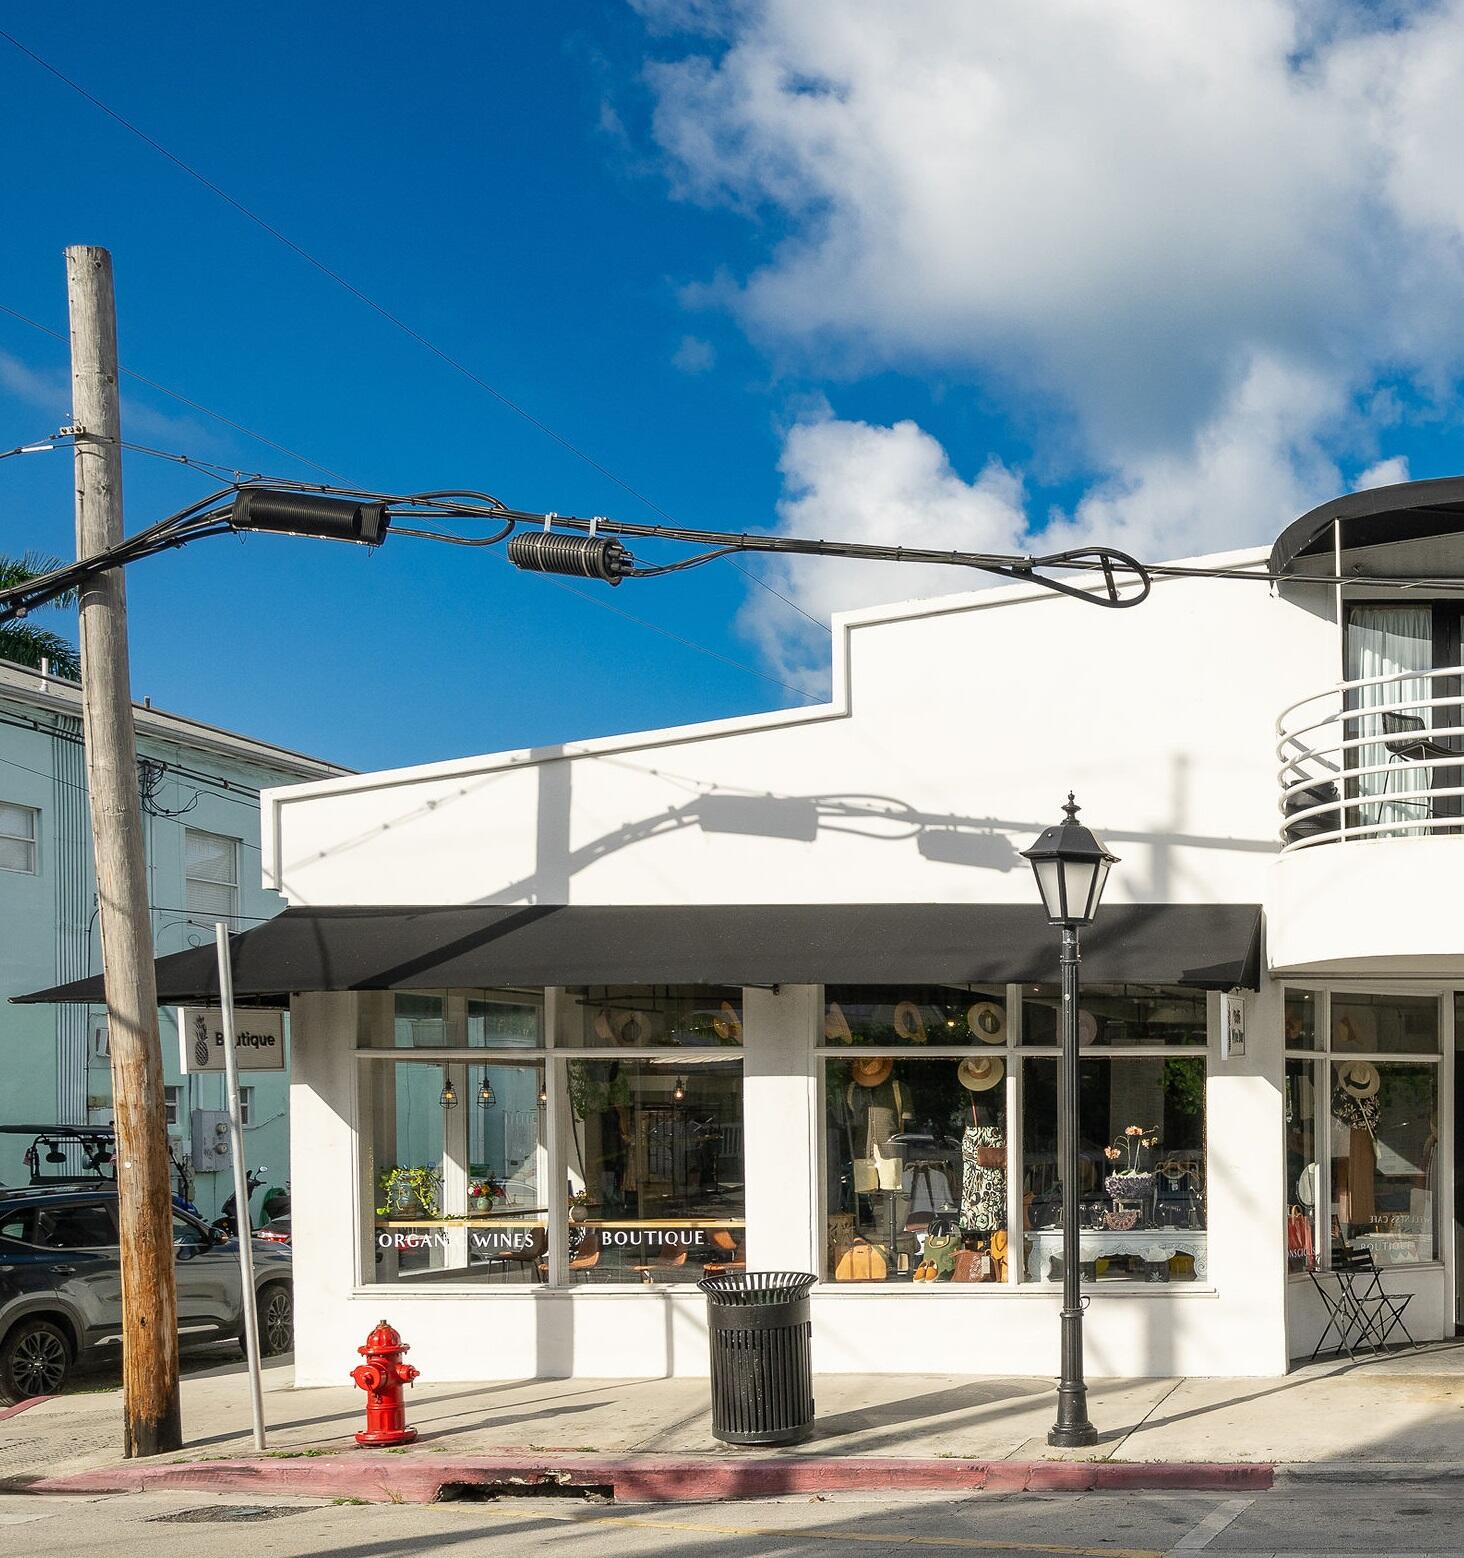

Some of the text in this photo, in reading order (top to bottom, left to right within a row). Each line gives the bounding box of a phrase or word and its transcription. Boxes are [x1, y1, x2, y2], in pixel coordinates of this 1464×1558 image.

[215, 1031, 276, 1050] Butique
[379, 1232, 534, 1248] ORGAN WINES
[602, 1230, 705, 1246] BOUTIQUE
